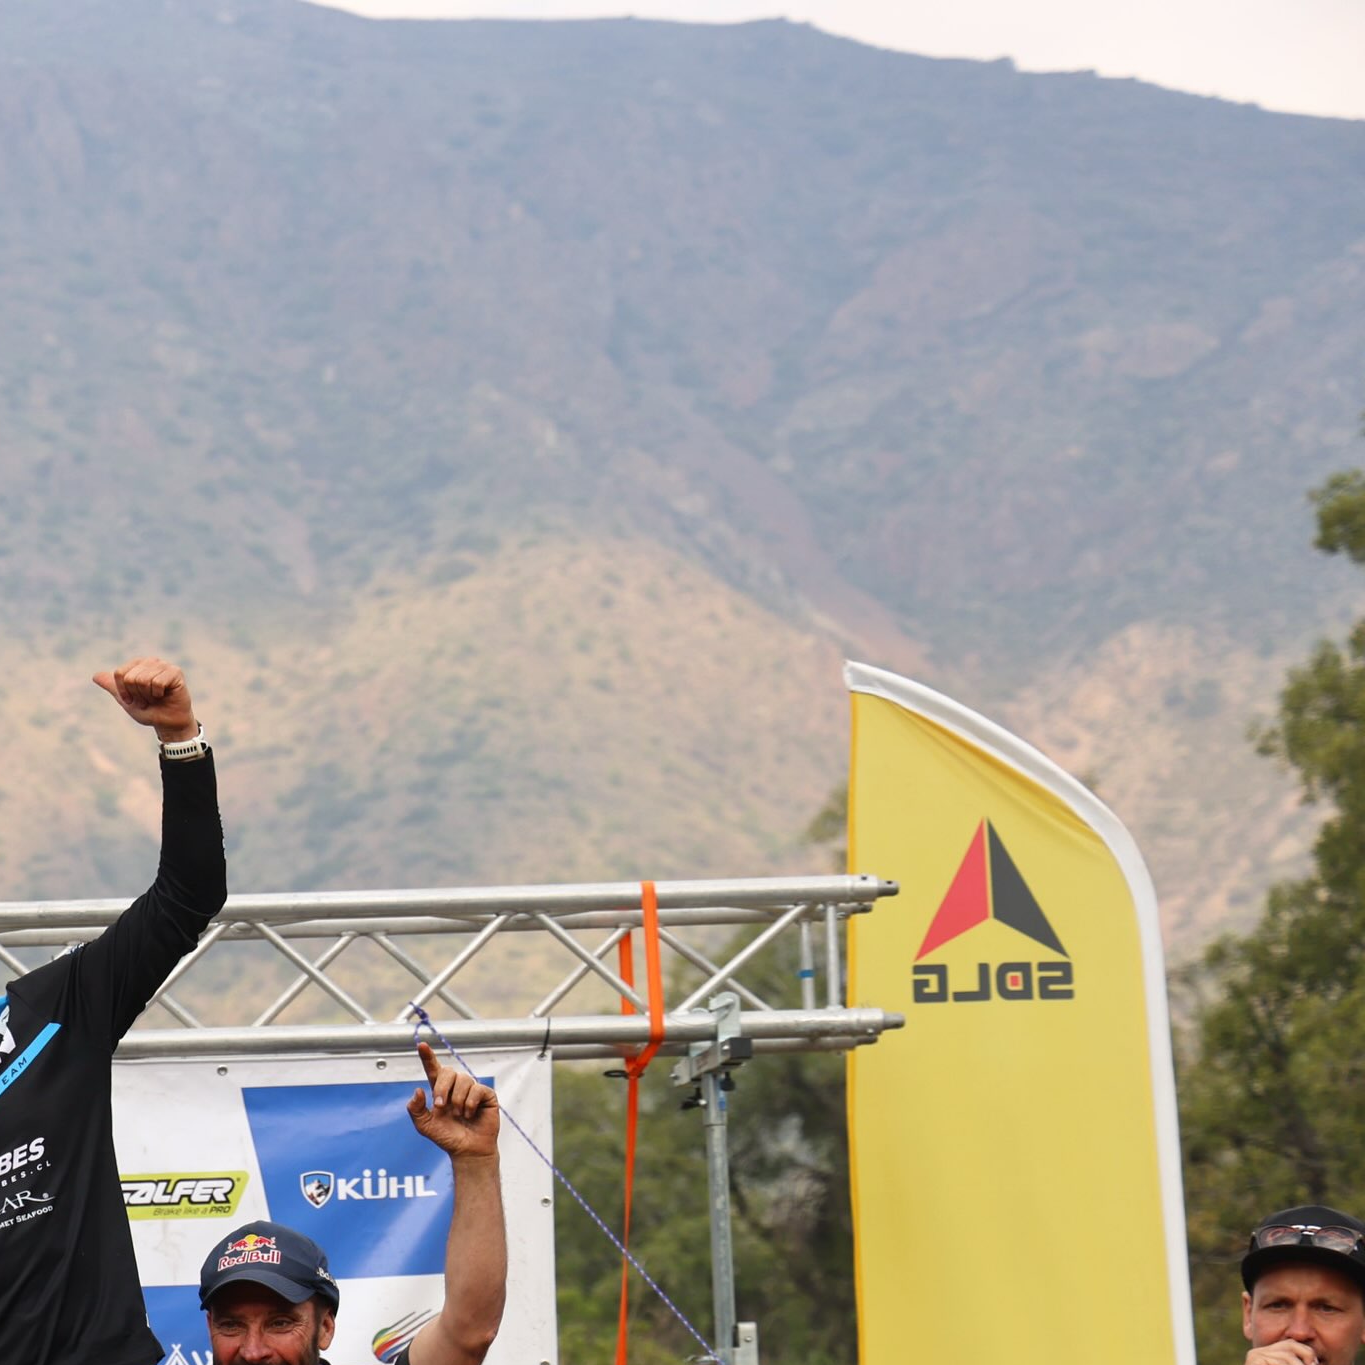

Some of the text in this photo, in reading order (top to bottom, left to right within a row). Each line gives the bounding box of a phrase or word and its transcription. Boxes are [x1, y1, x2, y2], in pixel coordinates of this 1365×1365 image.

[336, 1168, 437, 1200] KÜHL
[153, 1206, 182, 1217] Brake
[183, 1206, 200, 1216] like
[209, 1206, 231, 1214] PRO
[218, 1250, 282, 1272] Red Bull
